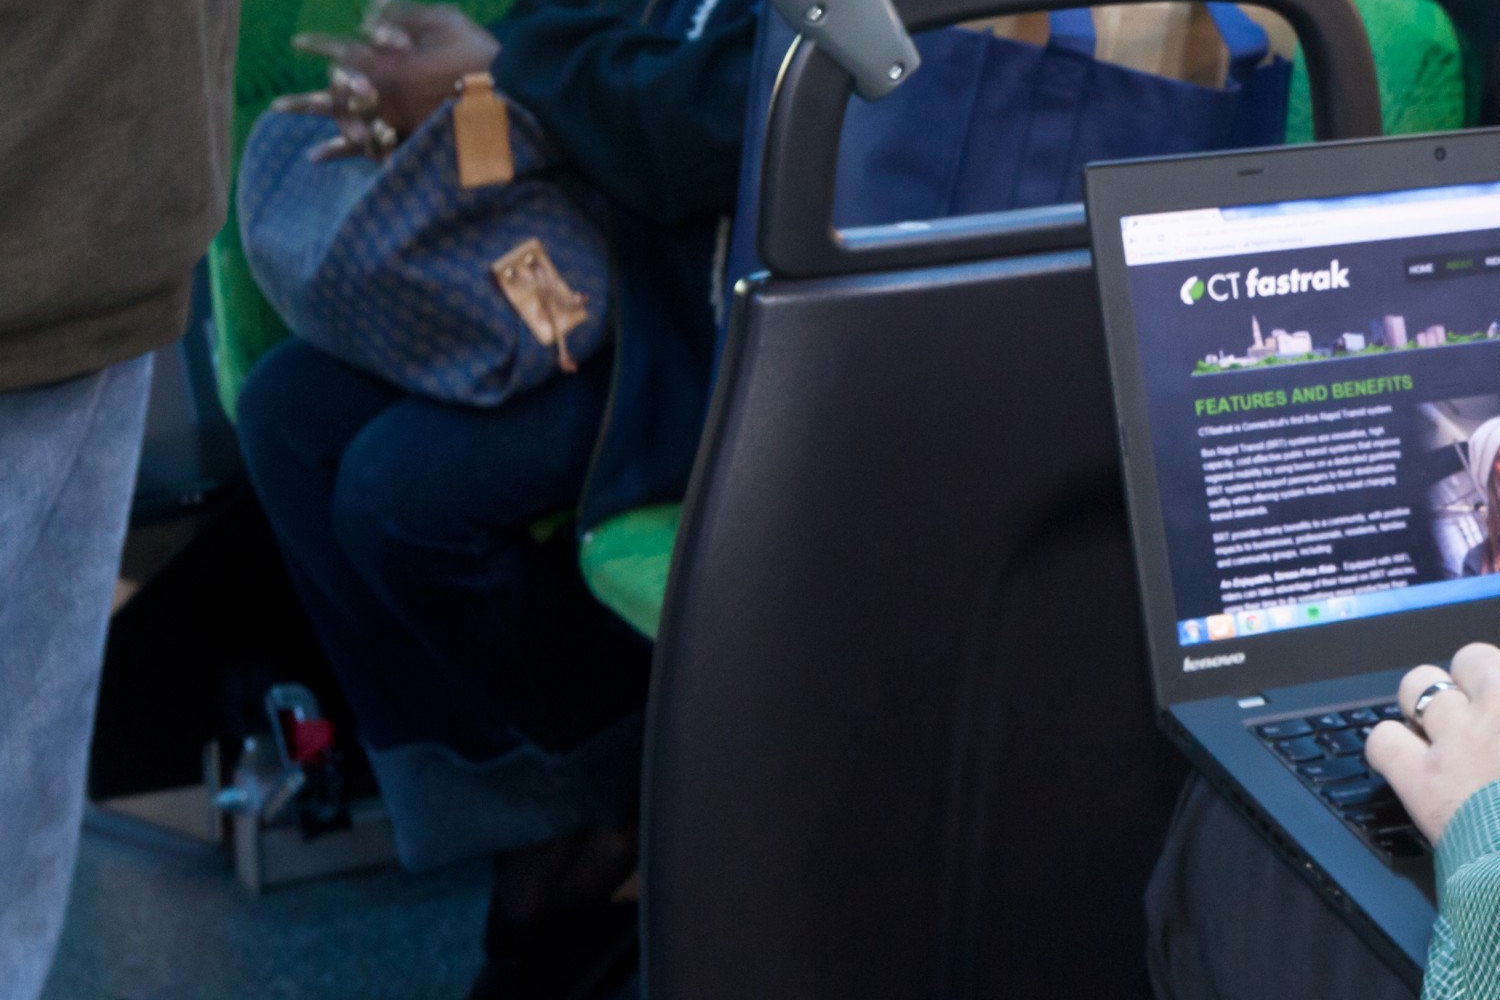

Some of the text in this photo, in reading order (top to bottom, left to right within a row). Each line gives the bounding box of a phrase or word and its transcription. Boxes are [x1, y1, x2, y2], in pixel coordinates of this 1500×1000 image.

[1205, 258, 1351, 302] CT fastrak
[1408, 263, 1433, 274] HOME
[1194, 373, 1413, 416] FEATURES AND BENEFITS
